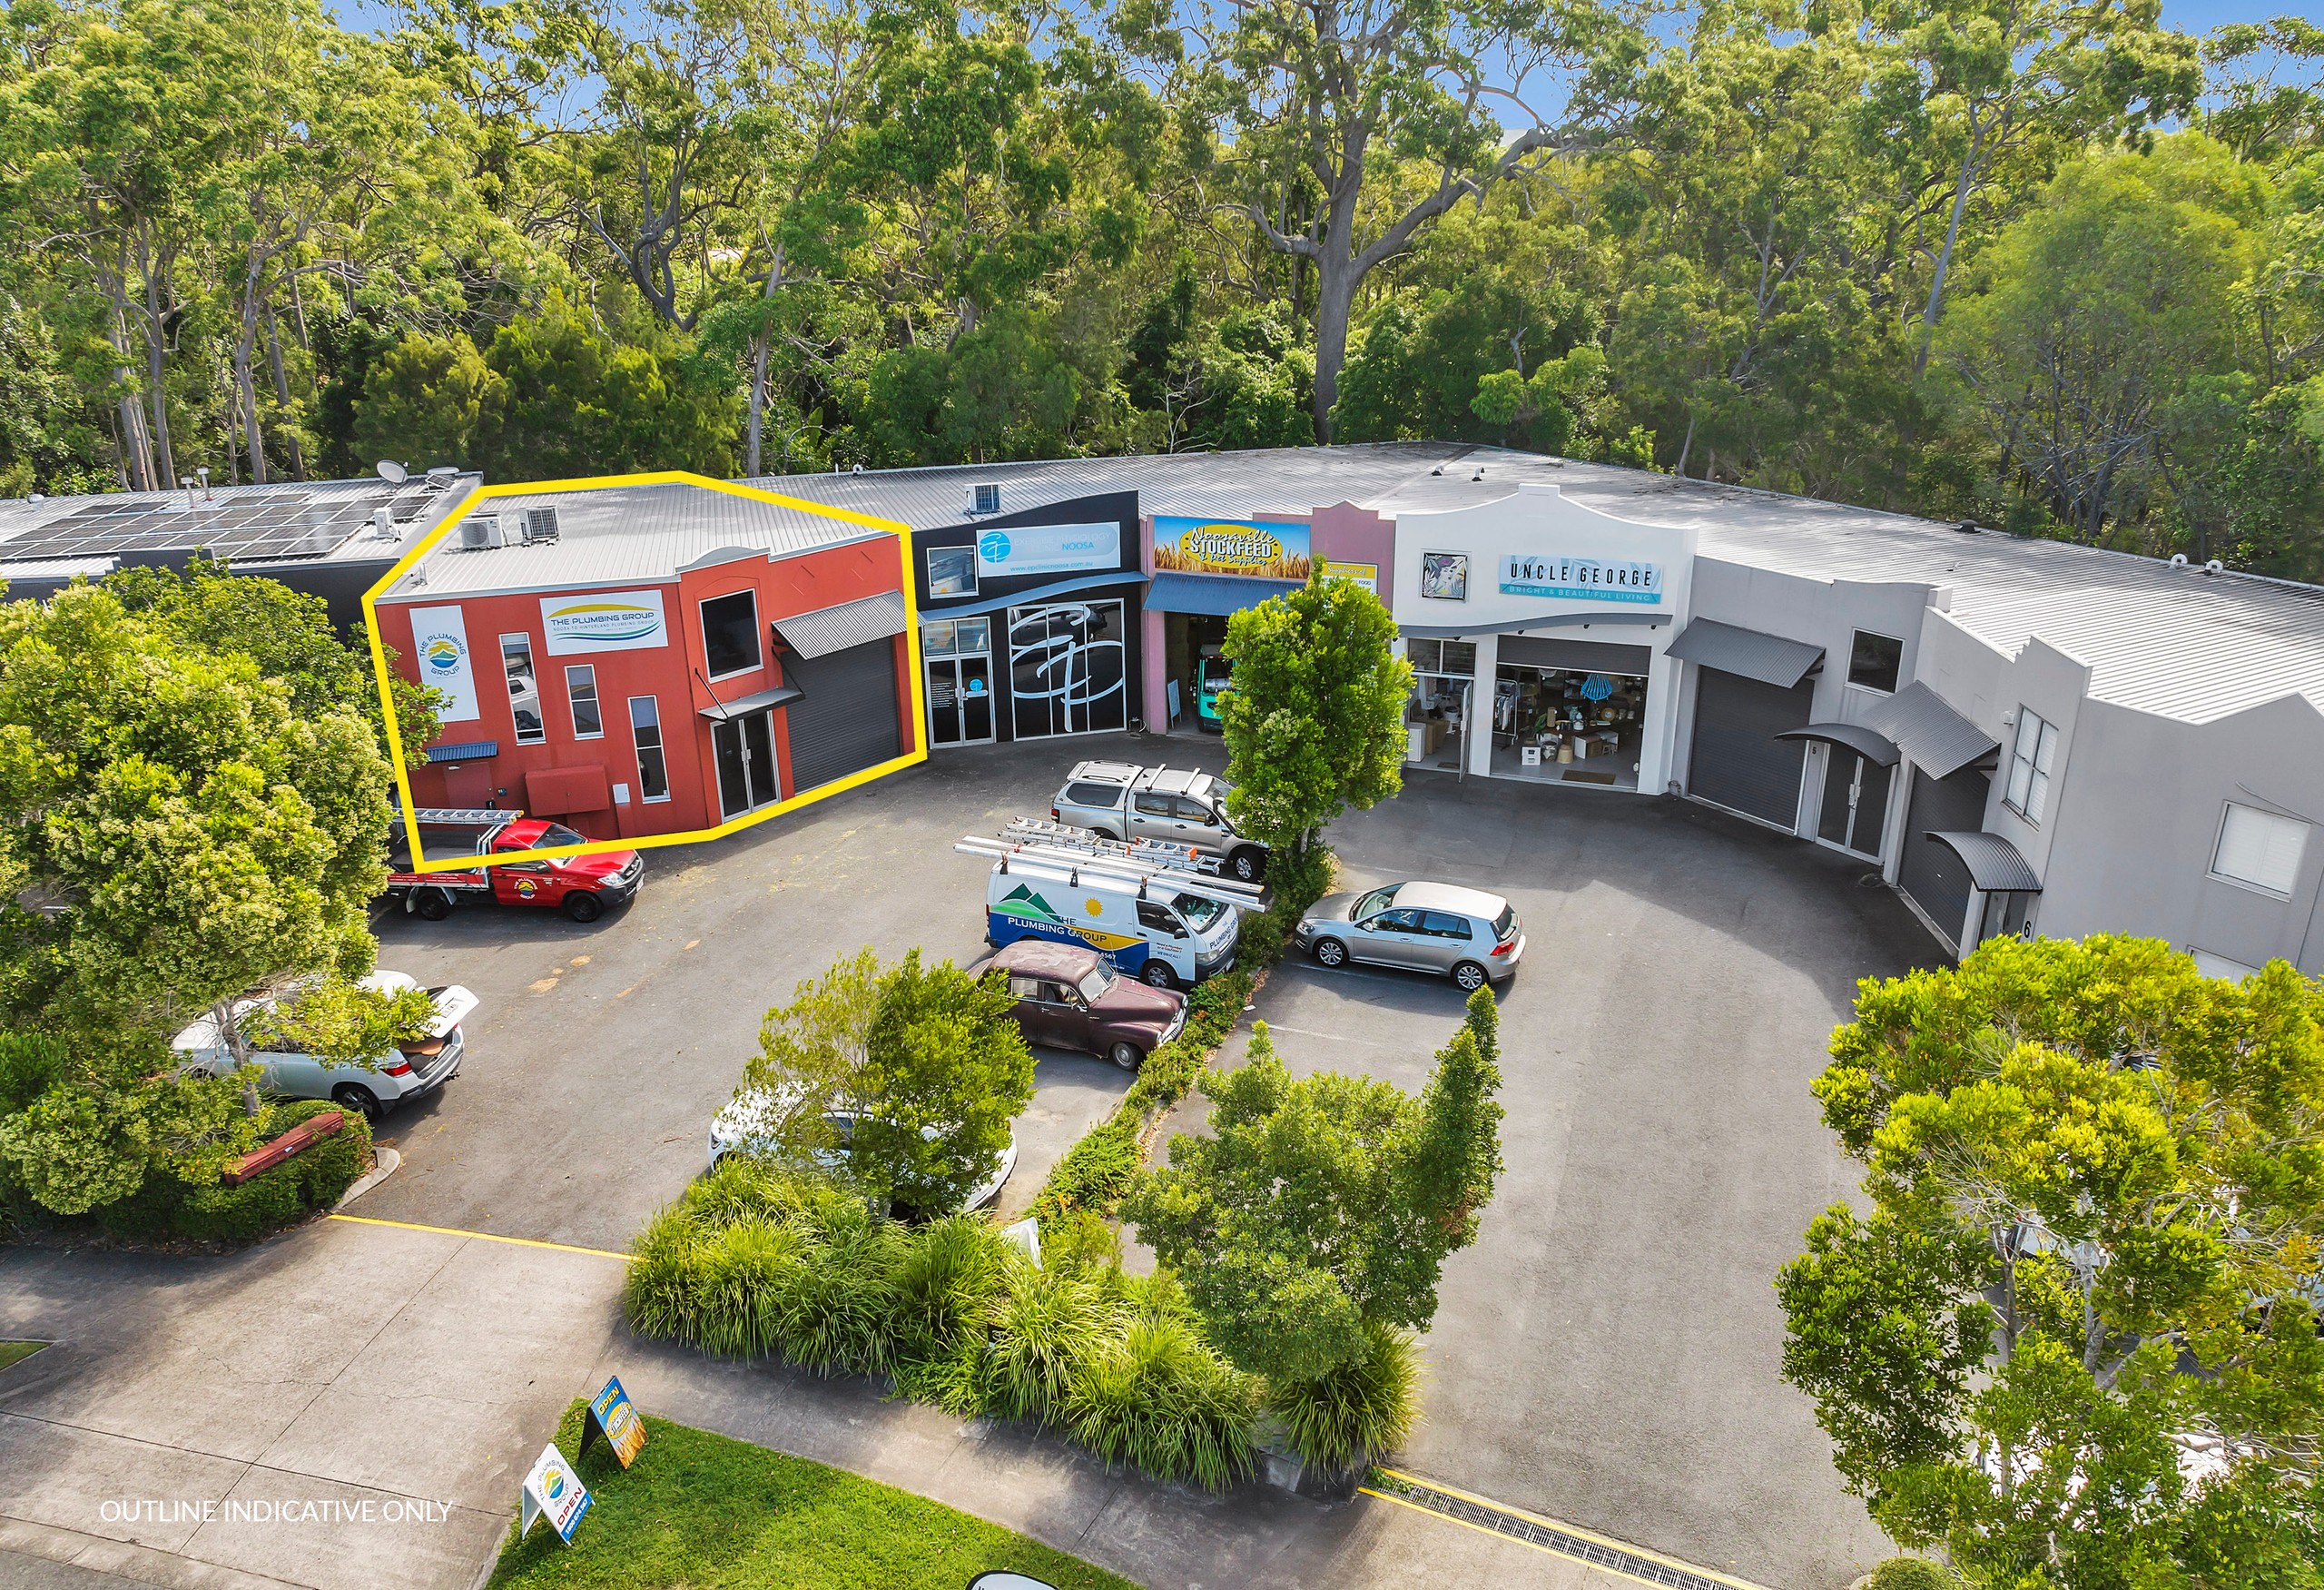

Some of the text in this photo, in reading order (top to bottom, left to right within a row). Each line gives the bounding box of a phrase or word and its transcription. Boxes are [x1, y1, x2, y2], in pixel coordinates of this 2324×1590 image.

[1191, 527, 1275, 543] Noosaville
[1062, 541, 1095, 551] NOOSA
[1189, 538, 1273, 558] STOCKFEED
[1210, 552, 1226, 562] Pet
[1228, 555, 1267, 566] Supplies
[1328, 565, 1357, 575] Suppliers
[1511, 563, 1651, 587] UNCLE GEORGE
[1509, 586, 1546, 594] BRIGHT
[1558, 588, 1612, 599] BEAUTIFUL
[1615, 593, 1650, 602] LIVING
[551, 611, 655, 627] THE PLUMBING GROUP
[419, 633, 467, 657] THE PLUMBING
[430, 665, 460, 676] GROUP
[1008, 916, 1108, 943] PLUMBING GROUP
[1209, 926, 1231, 949] PLUMBING
[2024, 920, 2032, 938] 6
[597, 1386, 620, 1416] OPEN
[537, 1459, 566, 1503] THE PLUMBING
[554, 1483, 569, 1507] GROUP
[557, 1486, 583, 1526] OPEN
[565, 1518, 576, 1535] 1800
